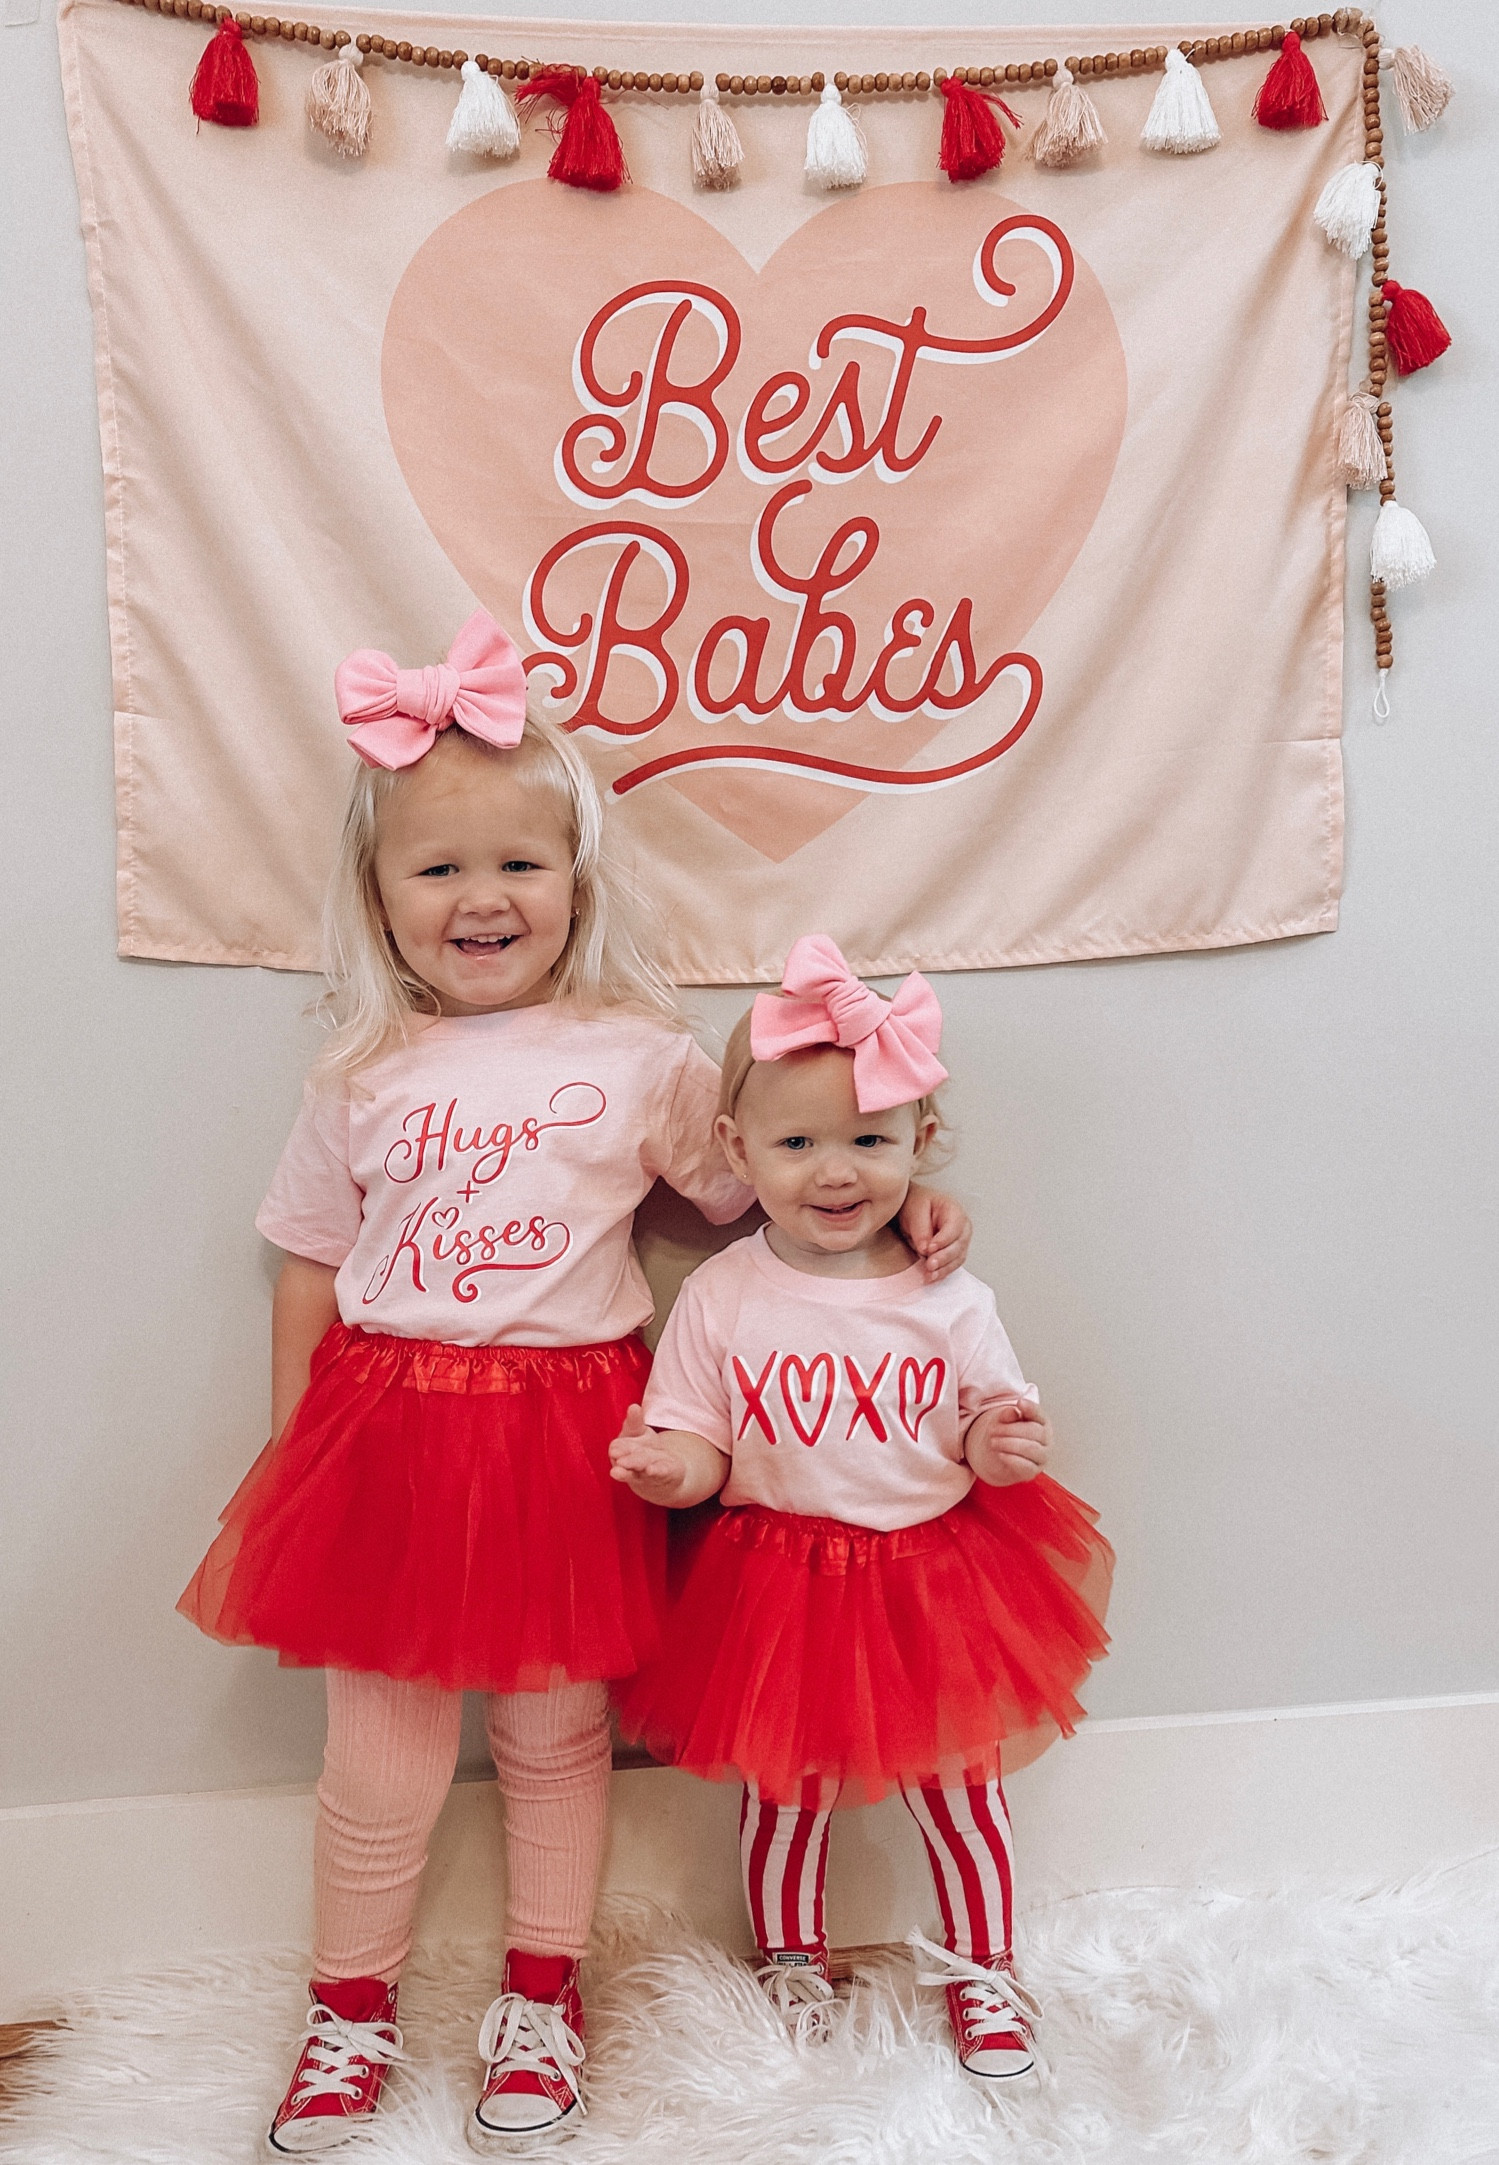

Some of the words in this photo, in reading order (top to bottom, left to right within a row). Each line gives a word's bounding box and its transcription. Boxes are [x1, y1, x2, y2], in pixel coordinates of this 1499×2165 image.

[554, 214, 1075, 511] Best
[522, 478, 1044, 804] Babes
[384, 1081, 608, 1185] Hugs
[456, 1180, 481, 1204] +
[361, 1196, 572, 1305] Kisses
